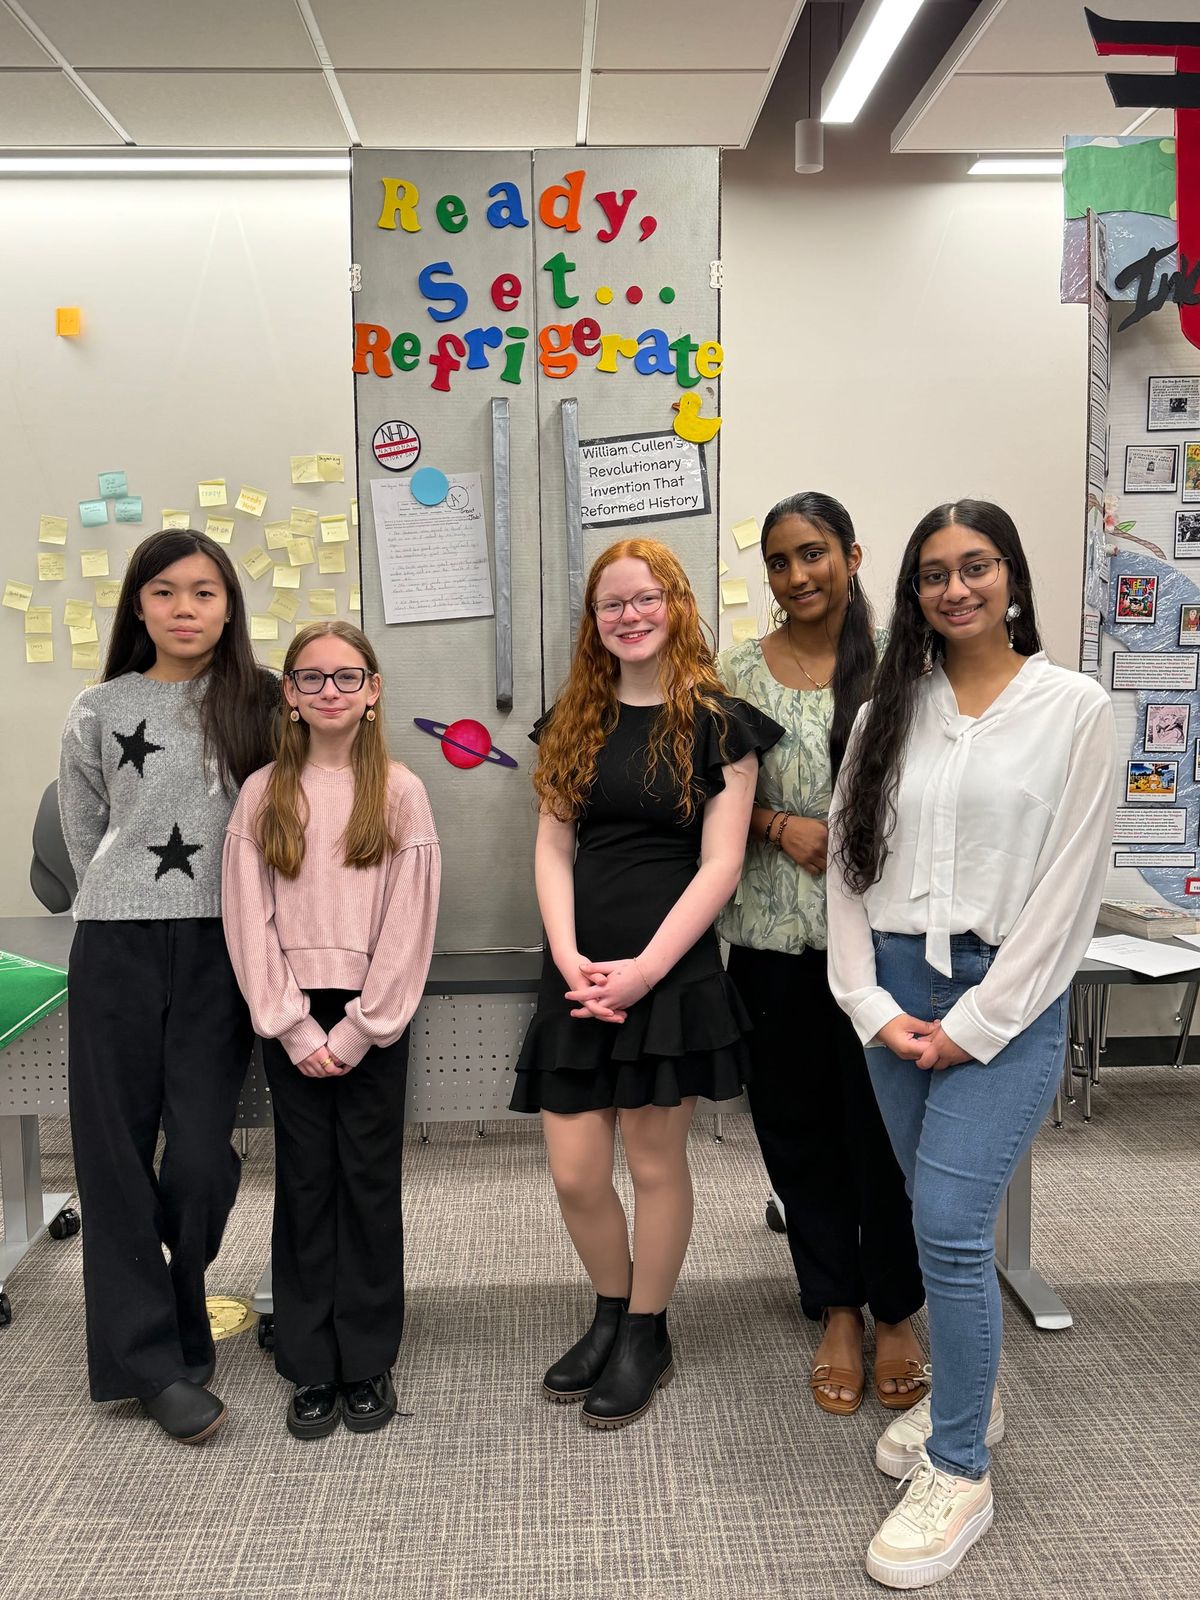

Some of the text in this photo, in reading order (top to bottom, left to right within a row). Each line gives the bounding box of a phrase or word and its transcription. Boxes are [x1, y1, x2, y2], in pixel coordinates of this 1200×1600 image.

[377, 170, 657, 243] Ready,
[418, 251, 676, 322] Set...
[351, 317, 724, 393] Refrigerate
[380, 424, 410, 443] NHD
[378, 443, 415, 453] NATIONAL
[582, 437, 684, 459] William Cullen's
[589, 459, 682, 478] Revolutionary
[590, 475, 685, 497] Invention That
[581, 495, 699, 517] Reformed History
